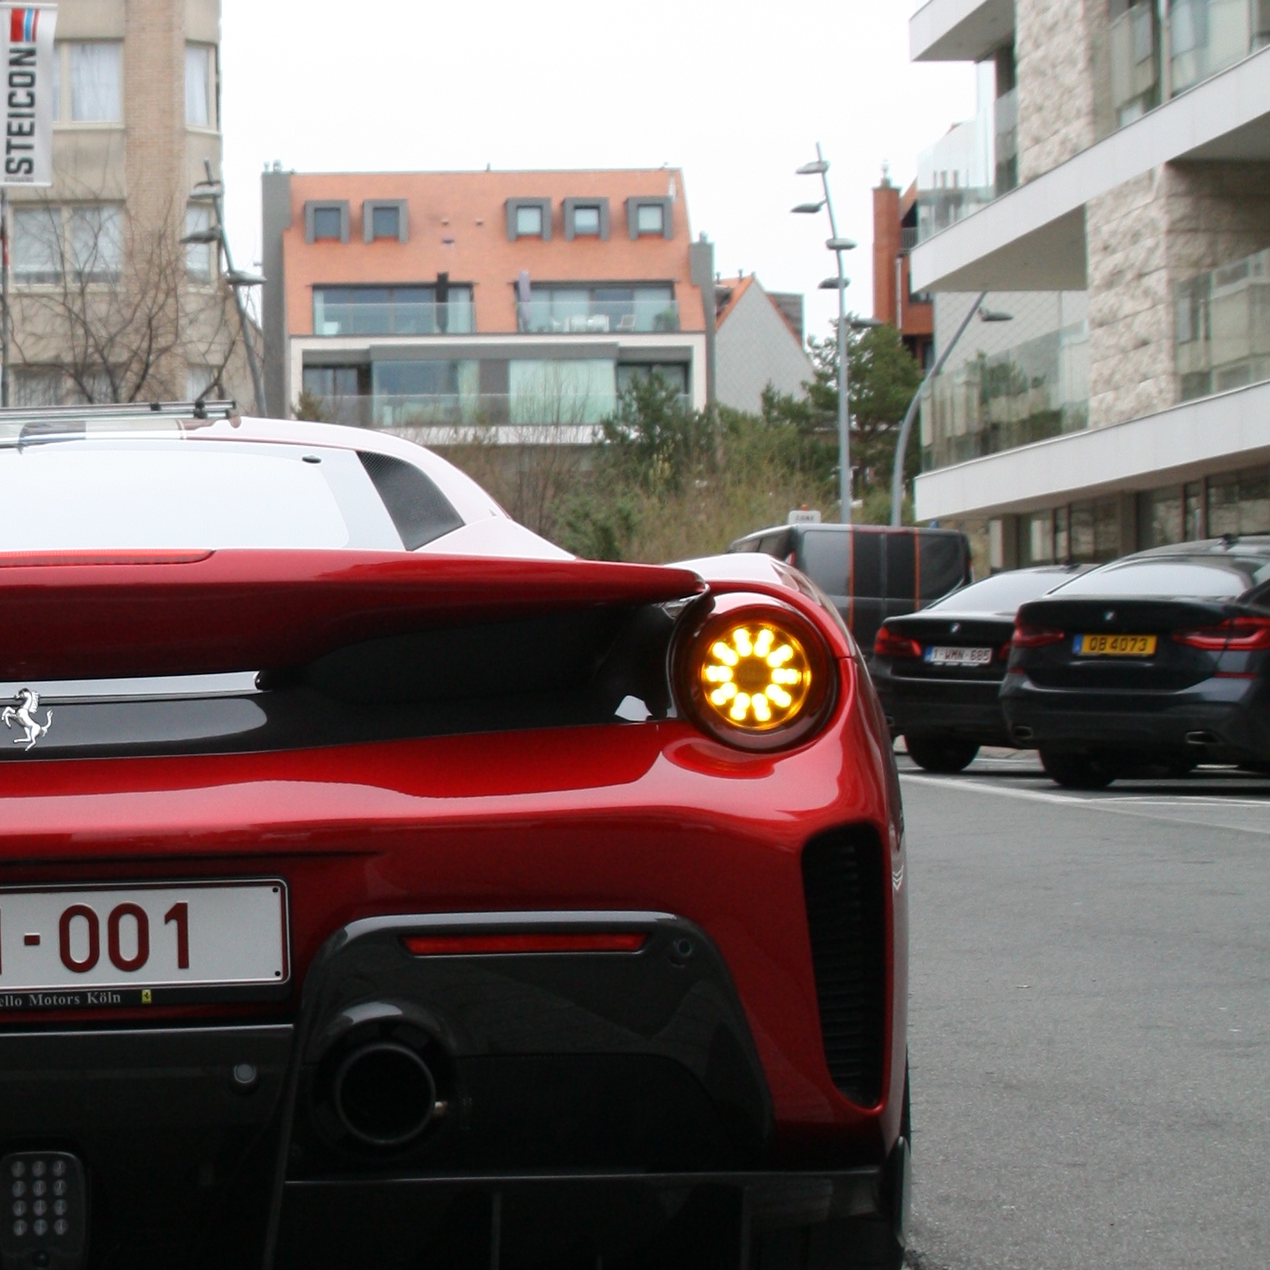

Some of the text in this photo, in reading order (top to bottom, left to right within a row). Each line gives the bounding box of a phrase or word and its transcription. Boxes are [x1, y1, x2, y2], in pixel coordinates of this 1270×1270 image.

[5, 47, 36, 175] STEICON
[29, 993, 80, 1006] Motors
[87, 991, 121, 1004] Köln
